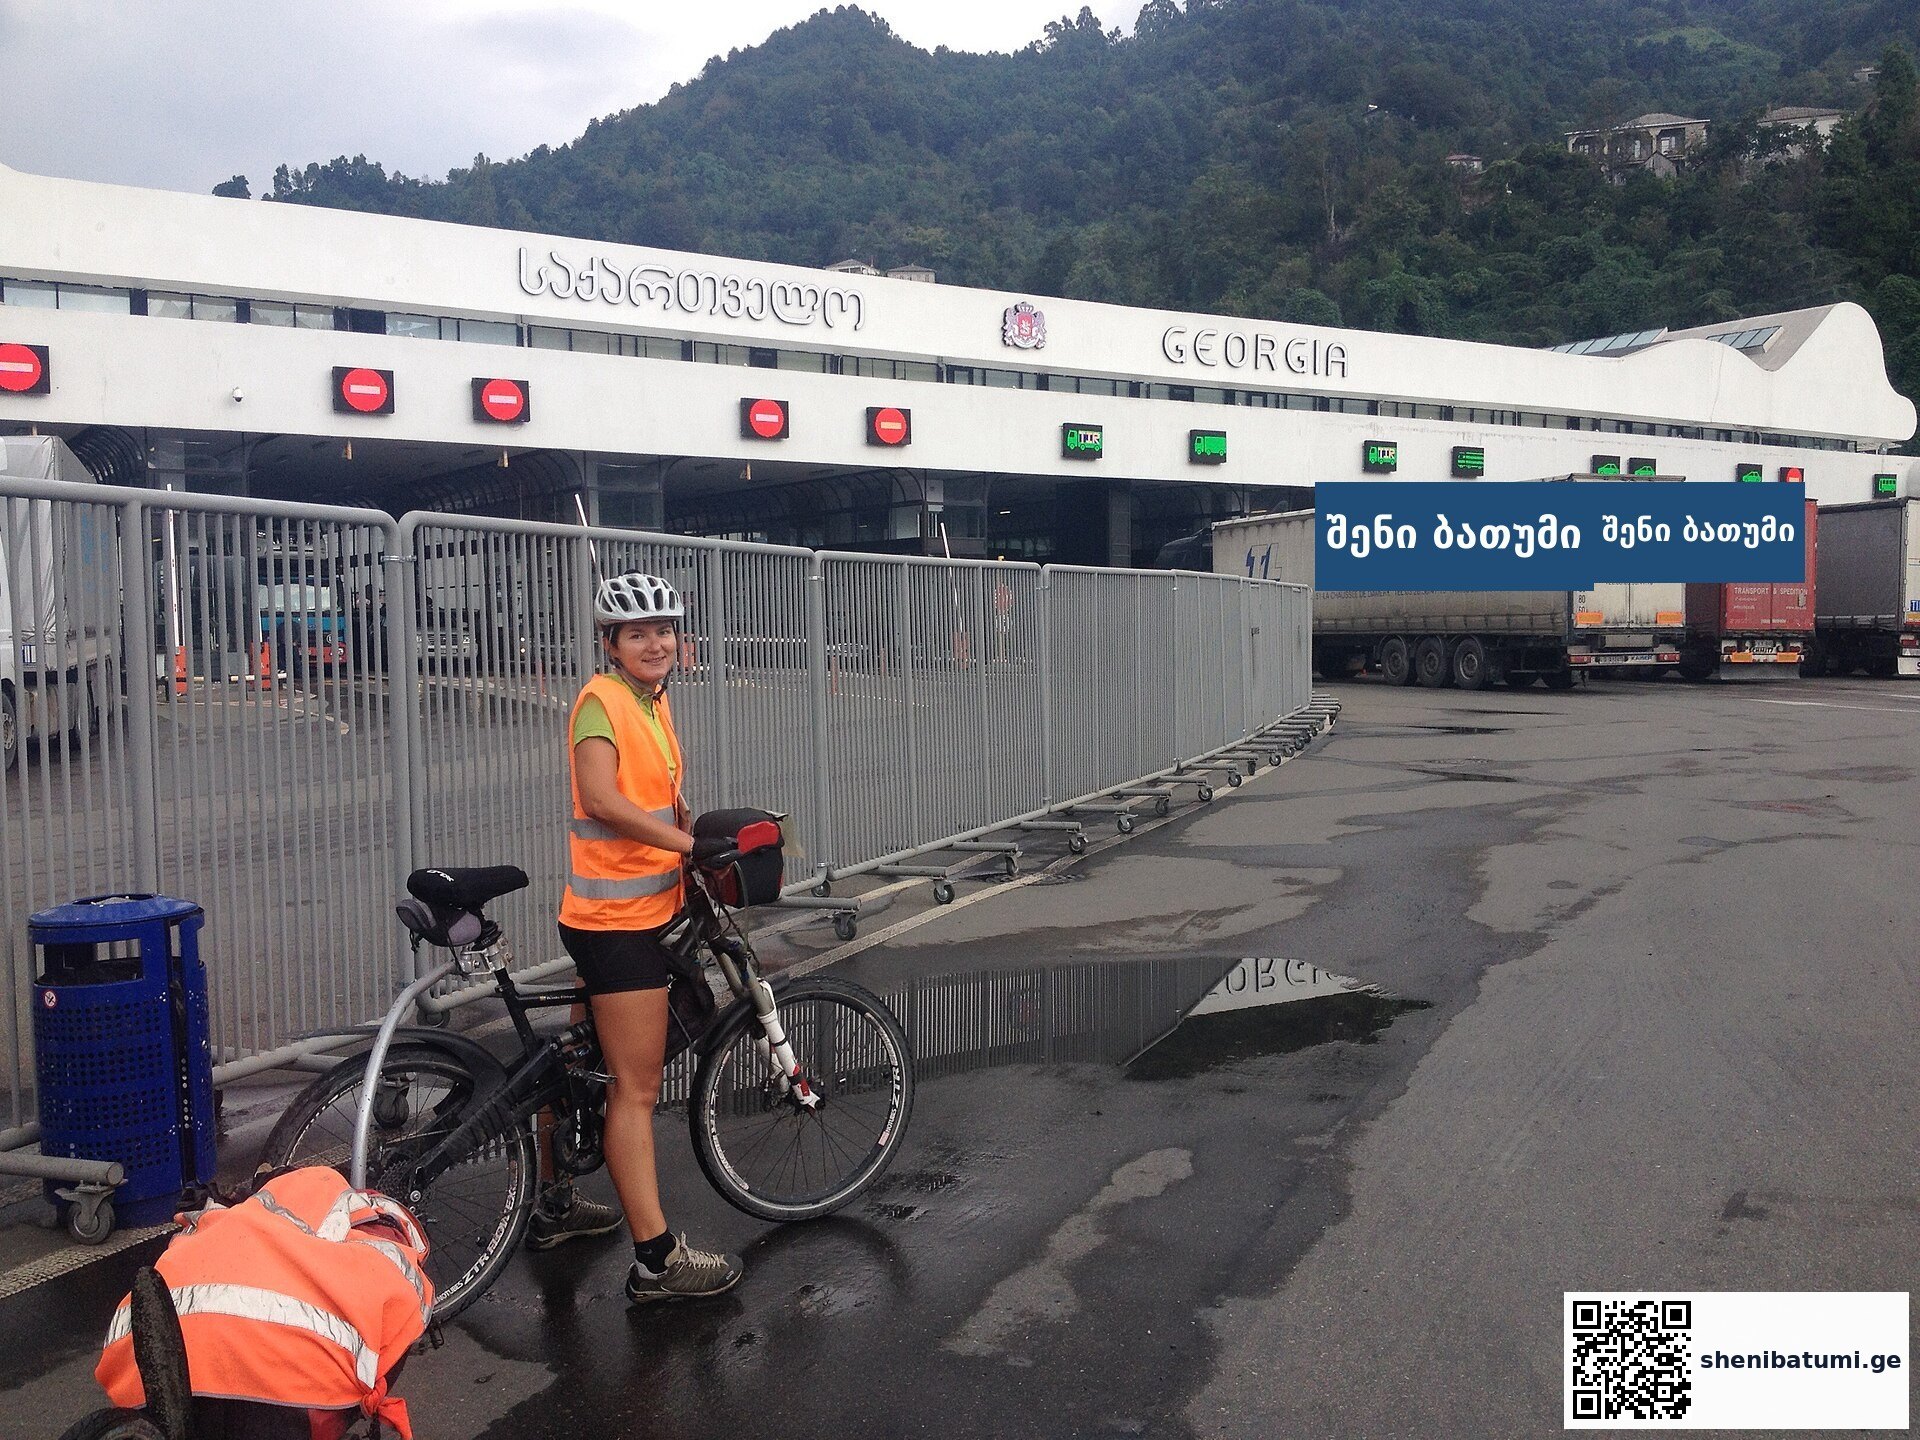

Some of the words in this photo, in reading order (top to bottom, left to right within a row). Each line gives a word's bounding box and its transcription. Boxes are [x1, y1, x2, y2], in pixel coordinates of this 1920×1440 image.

[519, 247, 865, 331] საქართველო
[1163, 326, 1348, 377] GEORGIA
[1078, 430, 1100, 445] TIR
[1378, 447, 1395, 459] TIR
[1734, 587, 1769, 595] TRANSPORT
[462, 1252, 490, 1285] ZTR
